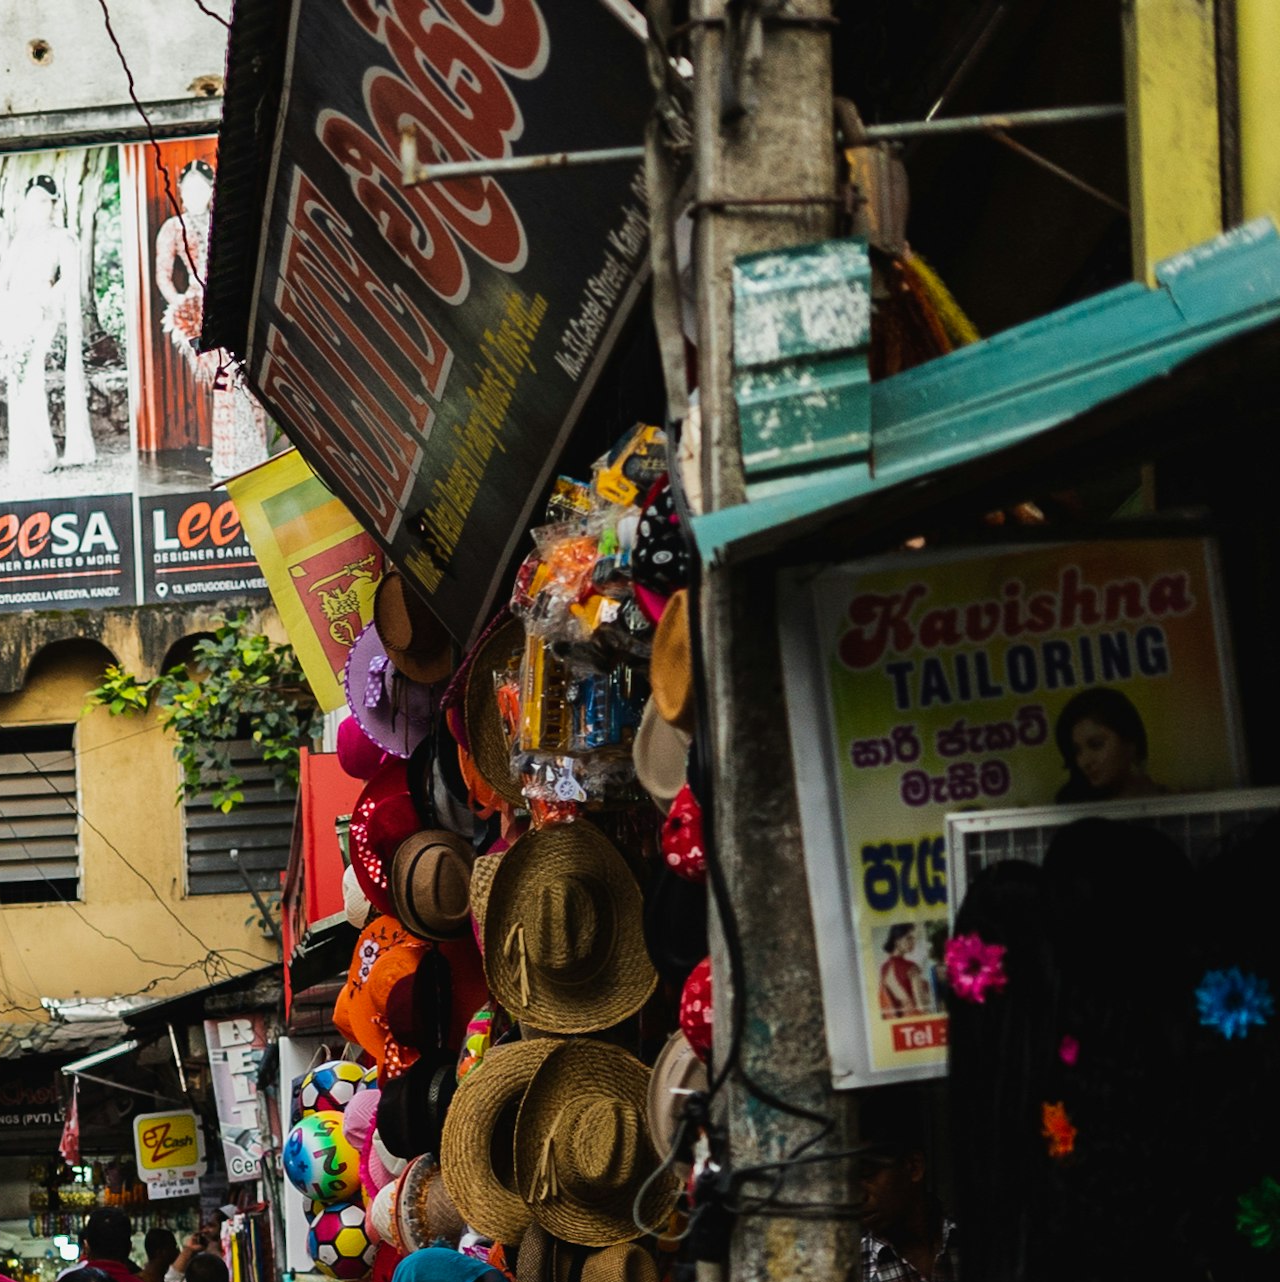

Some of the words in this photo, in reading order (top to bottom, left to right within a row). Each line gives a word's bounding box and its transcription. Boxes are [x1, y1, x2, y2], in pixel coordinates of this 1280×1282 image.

[259, 165, 454, 543] ELITE
[153, 501, 251, 551] Lee
[24, 558, 72, 571] SAREES
[87, 553, 120, 566] MORE
[154, 549, 214, 564] DESIGNER
[839, 565, 1194, 669] Kavishna
[886, 625, 1169, 711] TAILORING
[23, 1113, 51, 1127] (PVT)
[163, 1136, 194, 1149] Cash
